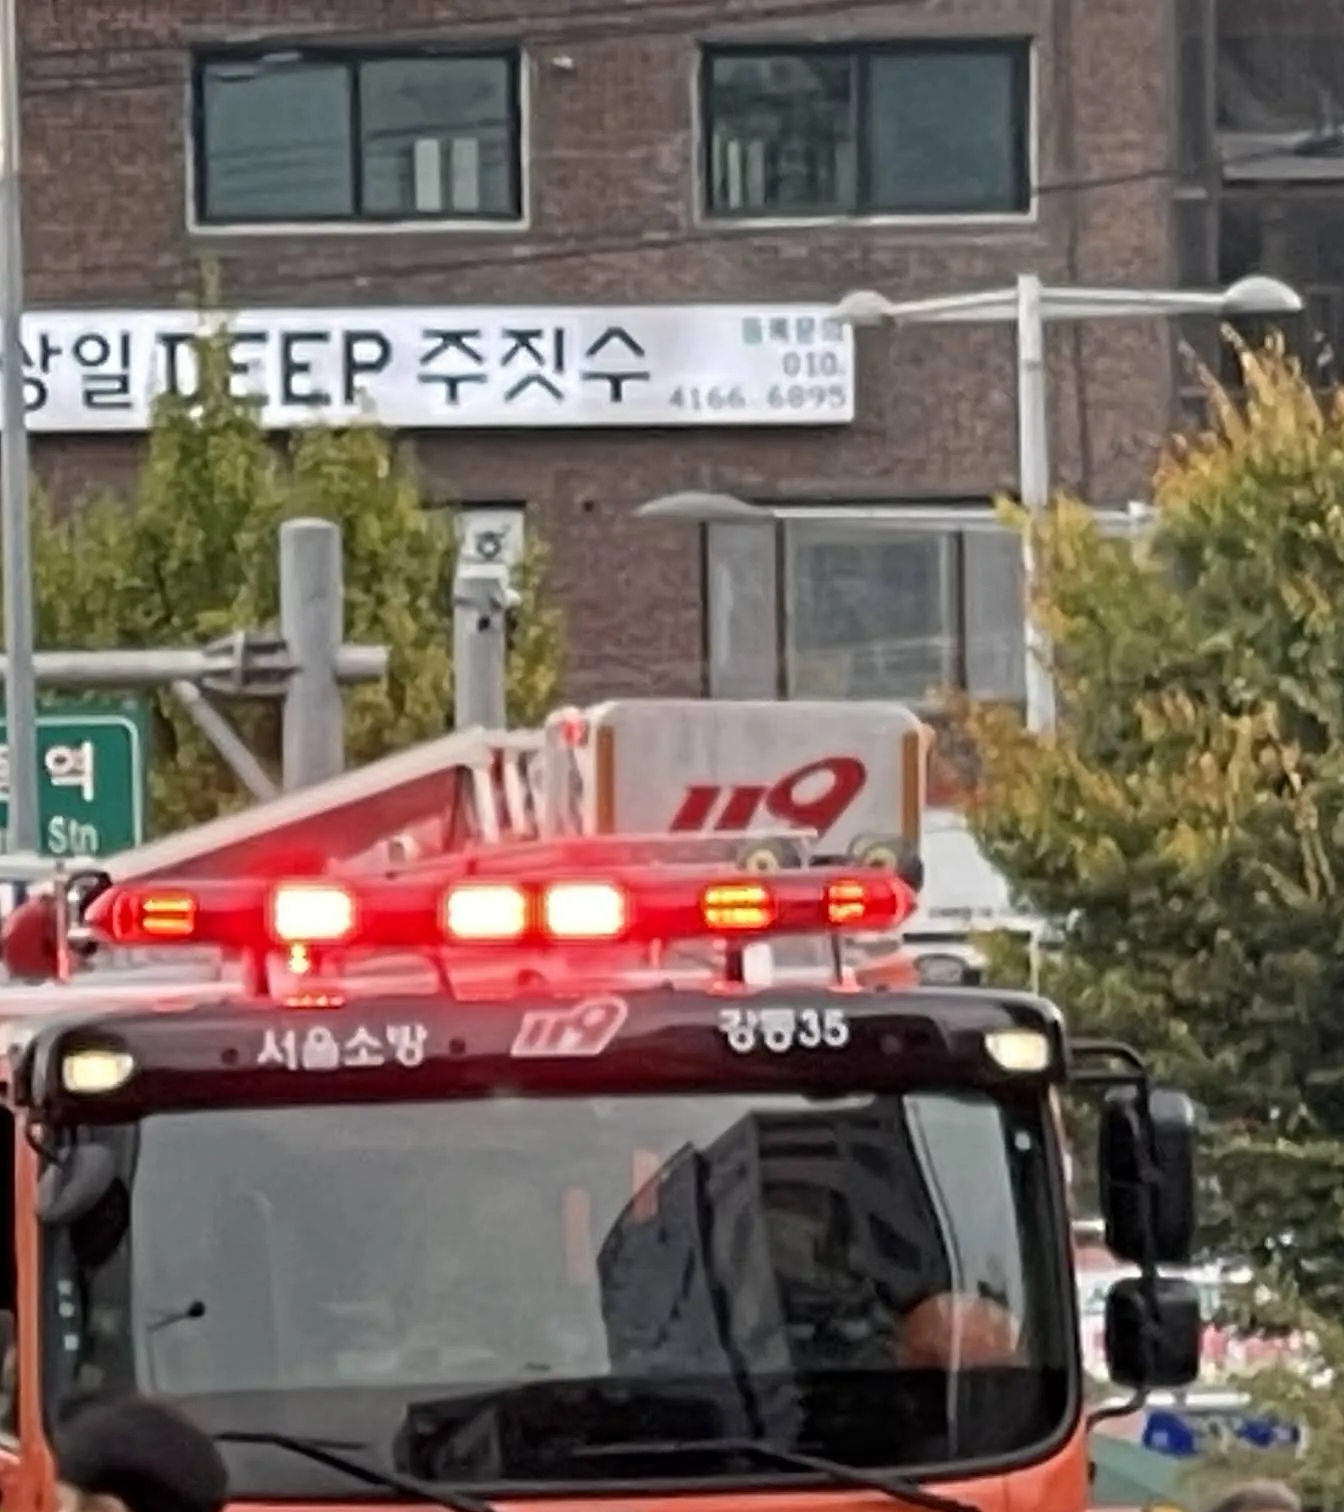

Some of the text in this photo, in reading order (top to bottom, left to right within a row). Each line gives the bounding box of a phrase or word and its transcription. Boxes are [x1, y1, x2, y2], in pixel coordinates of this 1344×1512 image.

[416, 325, 651, 406] 주짓수
[668, 757, 868, 840] 119
[48, 815, 99, 854] Stn
[256, 1022, 428, 1071] 서울소방
